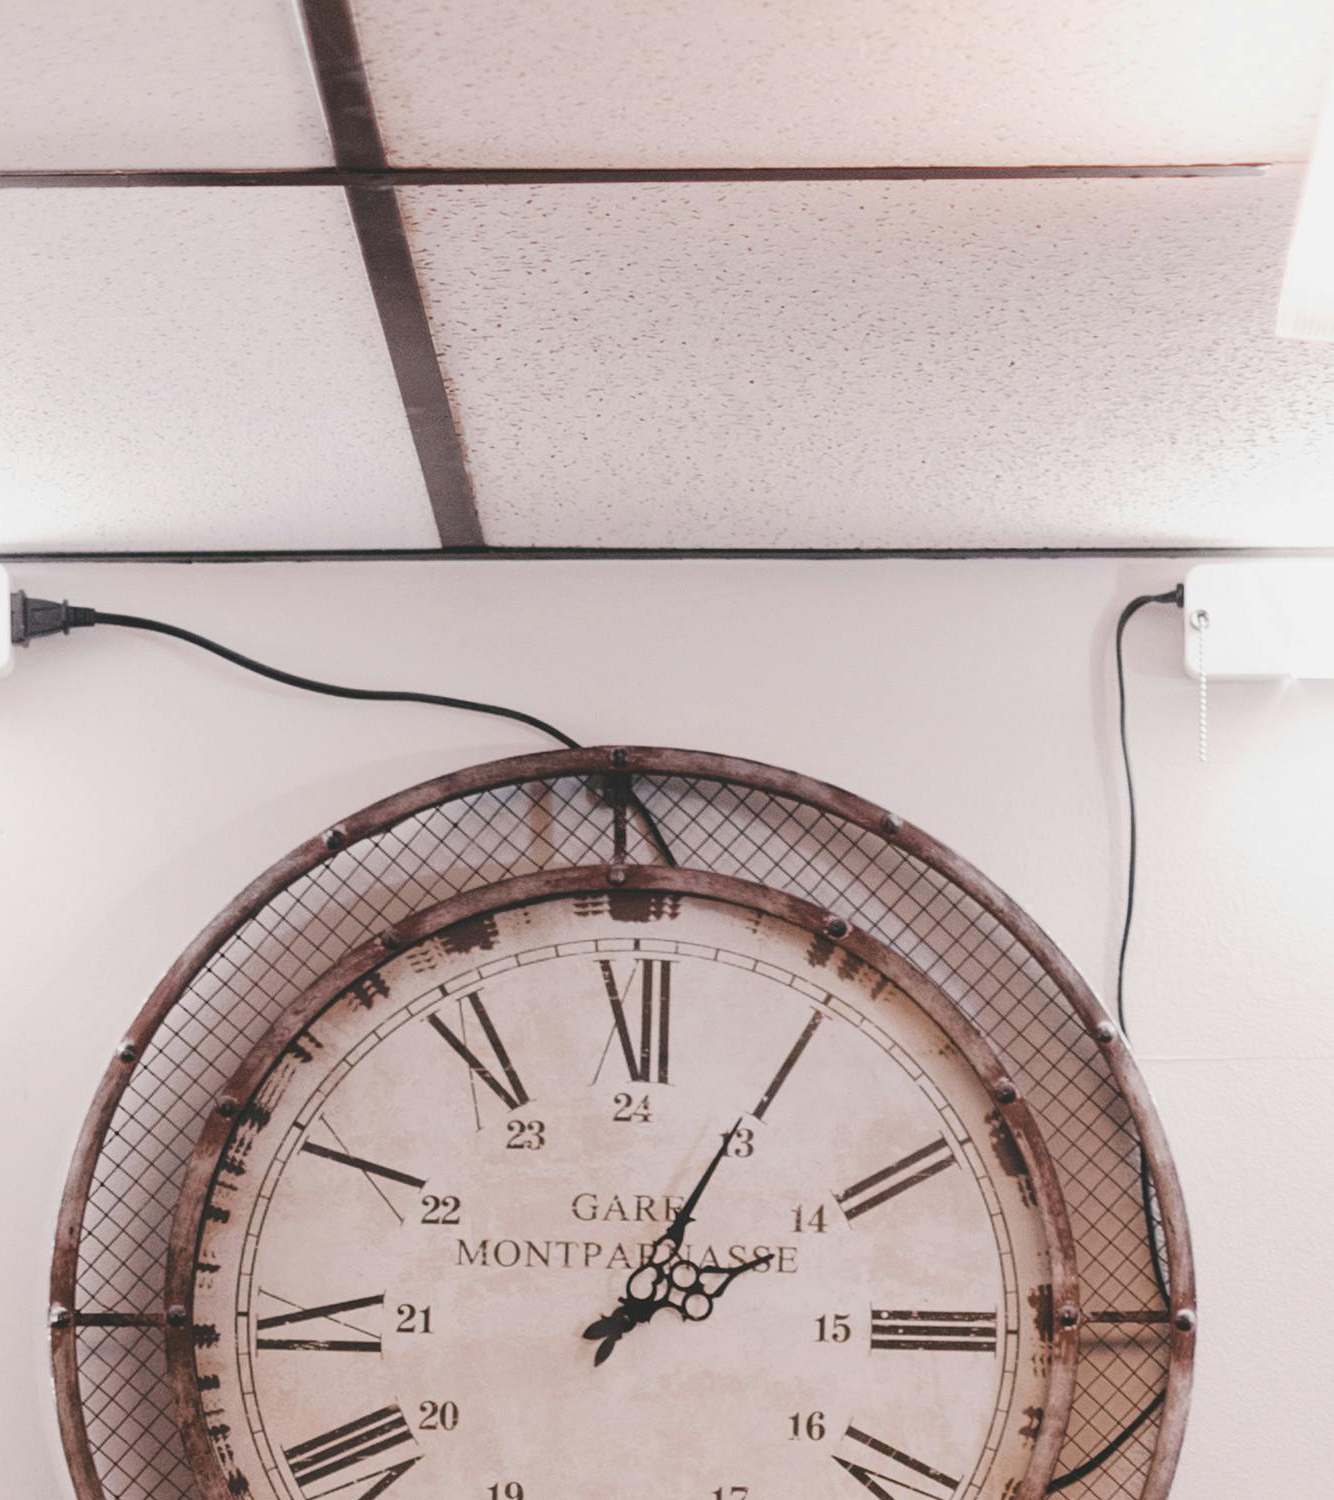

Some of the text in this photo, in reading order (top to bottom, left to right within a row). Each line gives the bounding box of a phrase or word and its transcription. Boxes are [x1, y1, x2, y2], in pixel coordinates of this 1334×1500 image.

[613, 1093, 653, 1124] 24
[505, 1121, 548, 1152] 23
[420, 1195, 462, 1227] 22
[571, 1193, 686, 1223] GARE
[791, 1205, 828, 1234] 14
[455, 1238, 799, 1274] MONTPARNASSE
[397, 1305, 434, 1336] 21
[814, 1315, 852, 1345] 15
[418, 1401, 460, 1433] 20
[788, 1411, 827, 1443] 16
